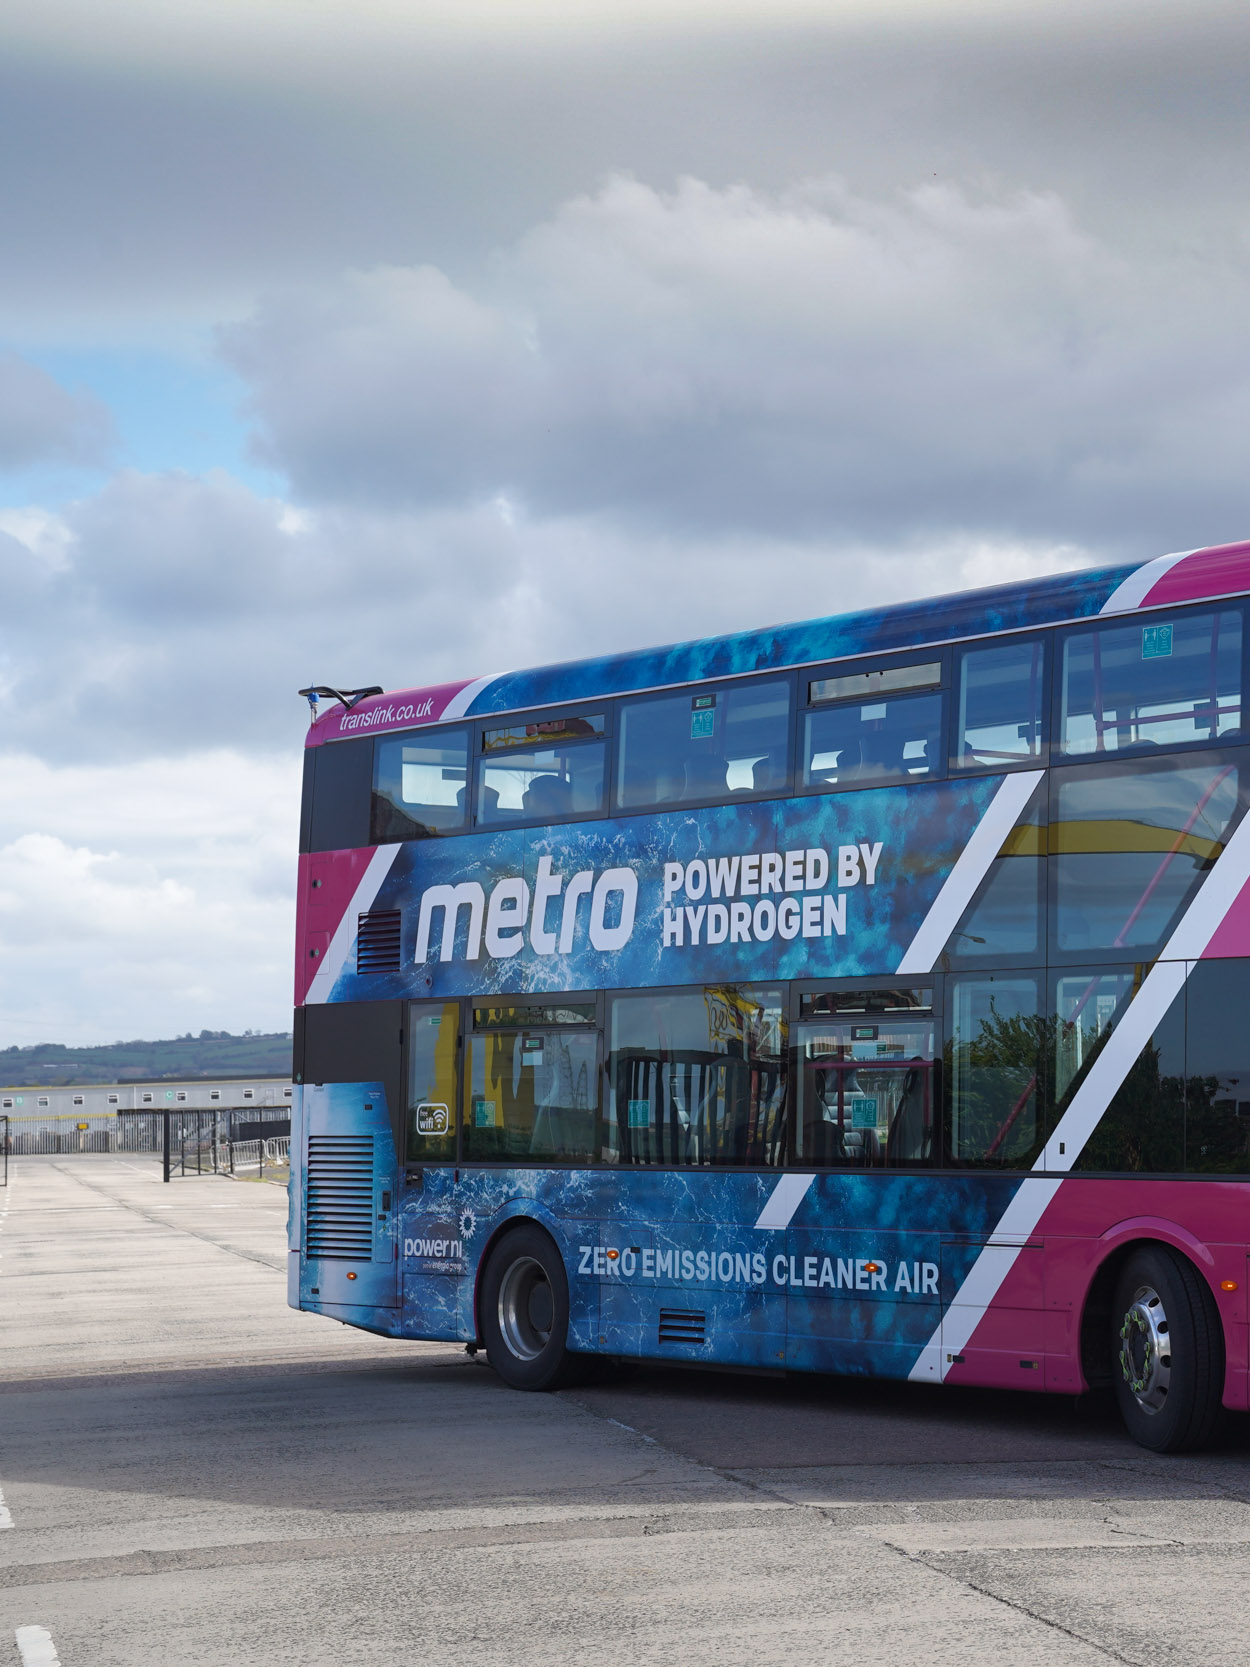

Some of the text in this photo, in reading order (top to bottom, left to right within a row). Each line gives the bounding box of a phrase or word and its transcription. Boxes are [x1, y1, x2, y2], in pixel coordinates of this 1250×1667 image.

[339, 697, 435, 731] translink.co.uk
[663, 841, 884, 902] POWERED BY
[414, 855, 639, 965] metro
[662, 893, 848, 948] HYDROGEN
[420, 1117, 434, 1129] wifi
[577, 1245, 940, 1295] ZERO EMISSIONS CLEANER AIR
